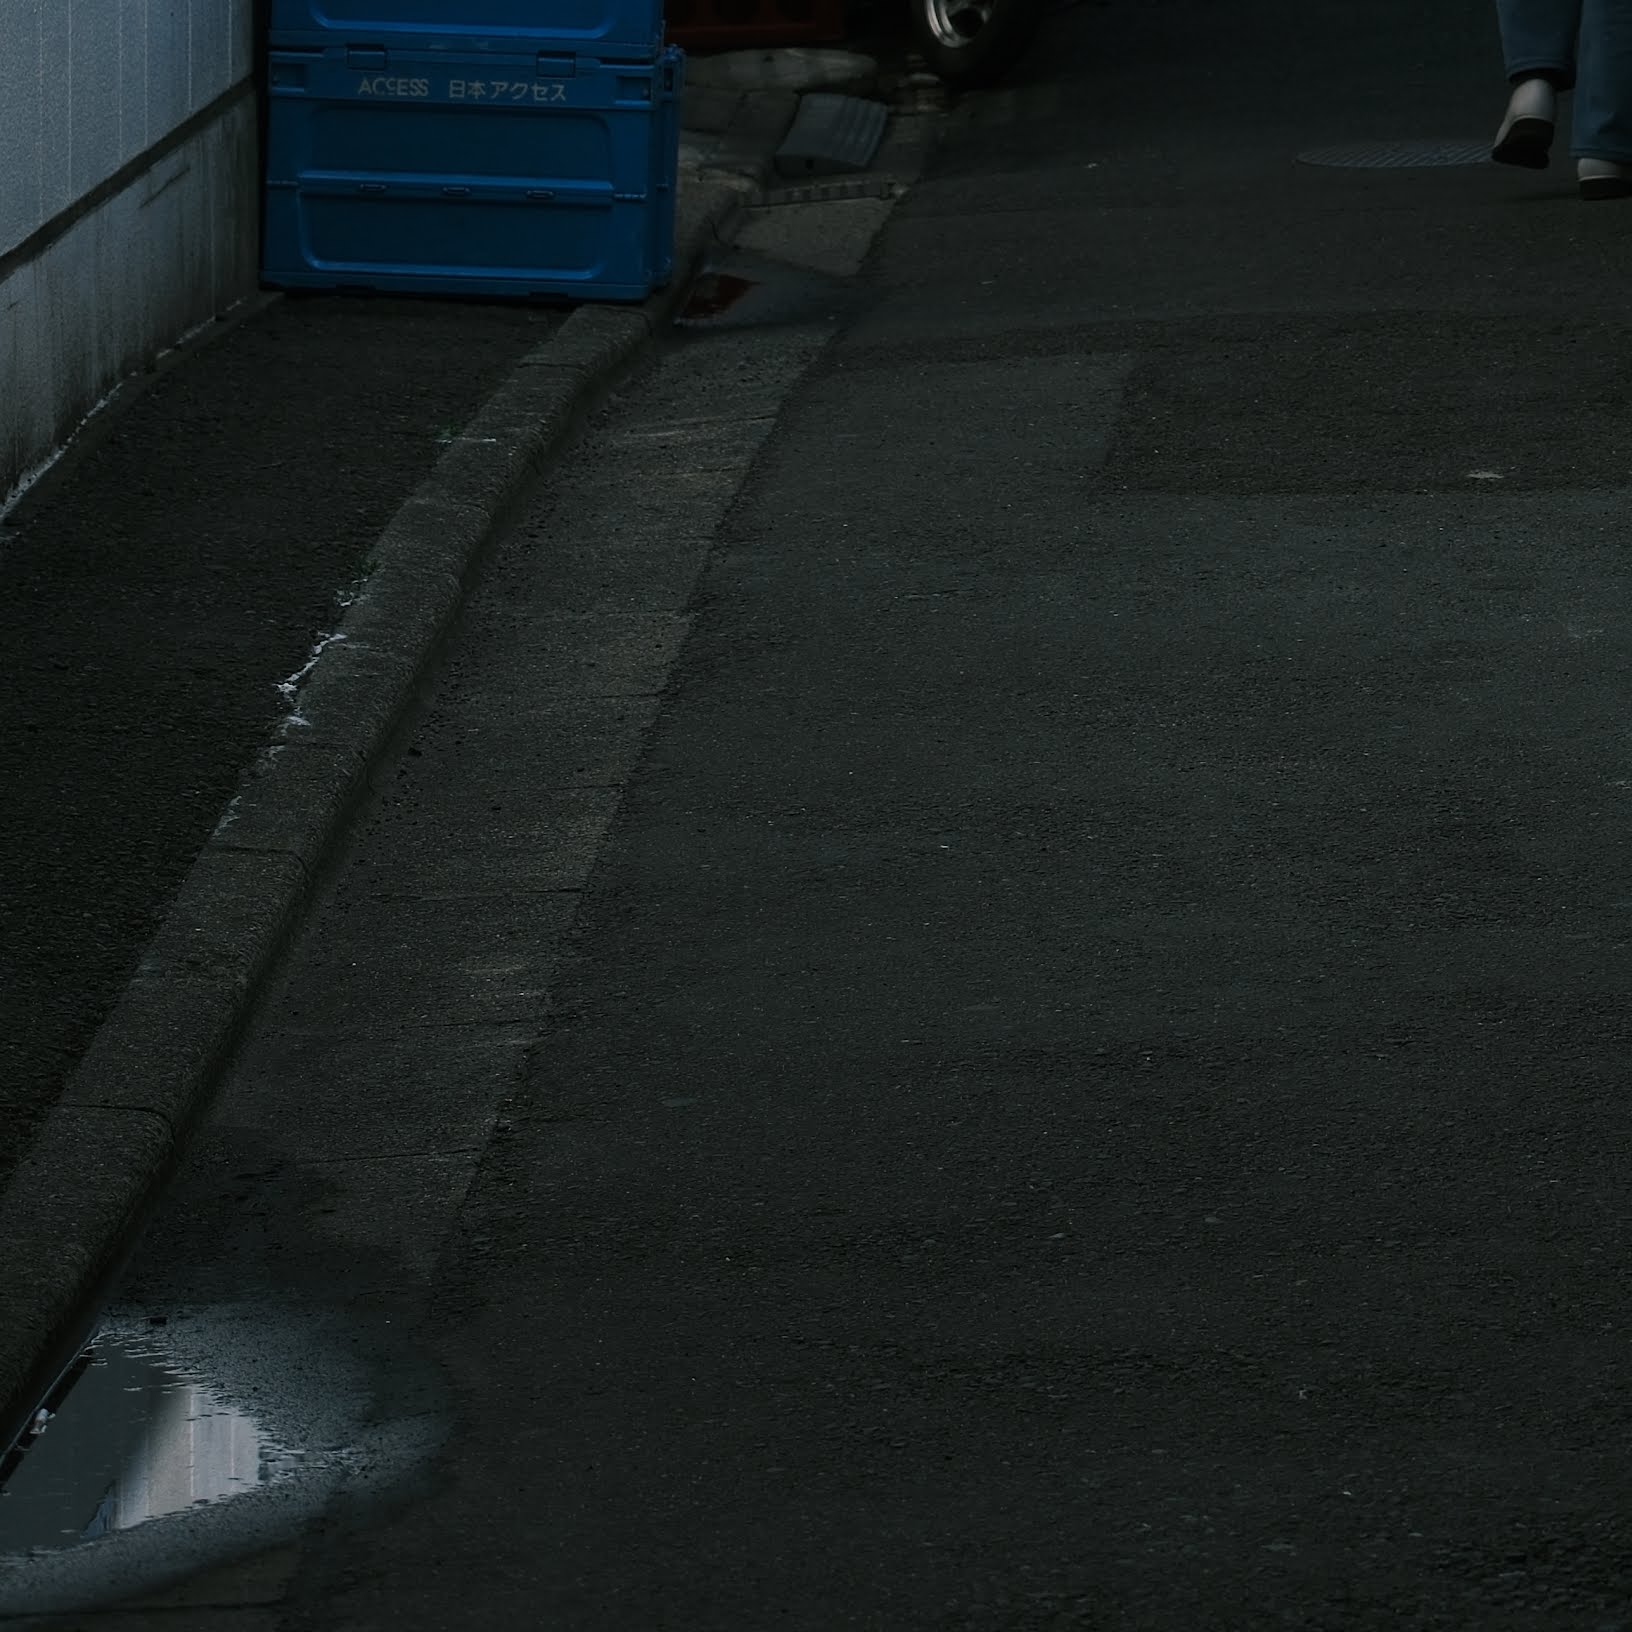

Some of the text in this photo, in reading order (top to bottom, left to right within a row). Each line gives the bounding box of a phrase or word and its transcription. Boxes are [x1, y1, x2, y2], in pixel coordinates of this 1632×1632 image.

[448, 79, 566, 103] 日本アクセス
